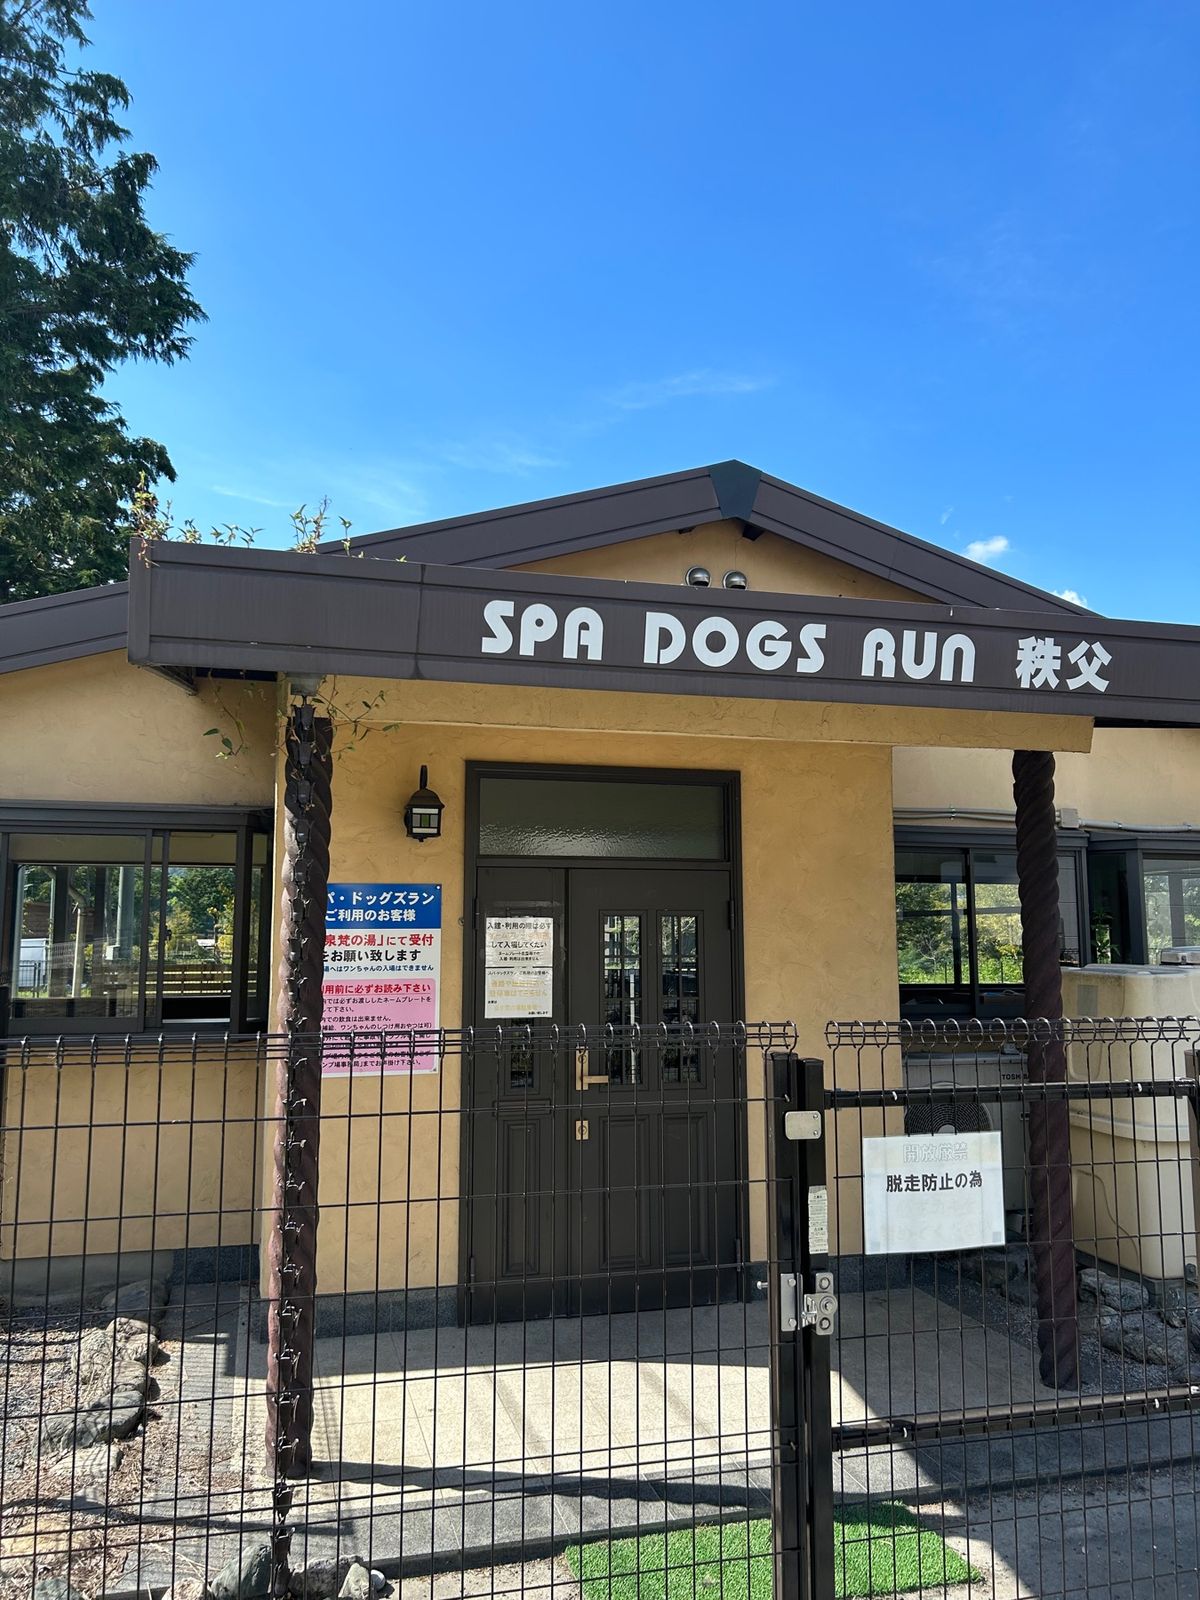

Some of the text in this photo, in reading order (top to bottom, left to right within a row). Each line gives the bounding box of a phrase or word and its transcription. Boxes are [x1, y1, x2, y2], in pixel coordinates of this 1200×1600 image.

[482, 600, 1112, 692] SPA DOGS RUN 秩父
[325, 909, 416, 922] ご利用のお客様
[322, 984, 431, 994] 用前に必ずお読み下さい
[886, 1170, 983, 1193] 脱走防止の為
